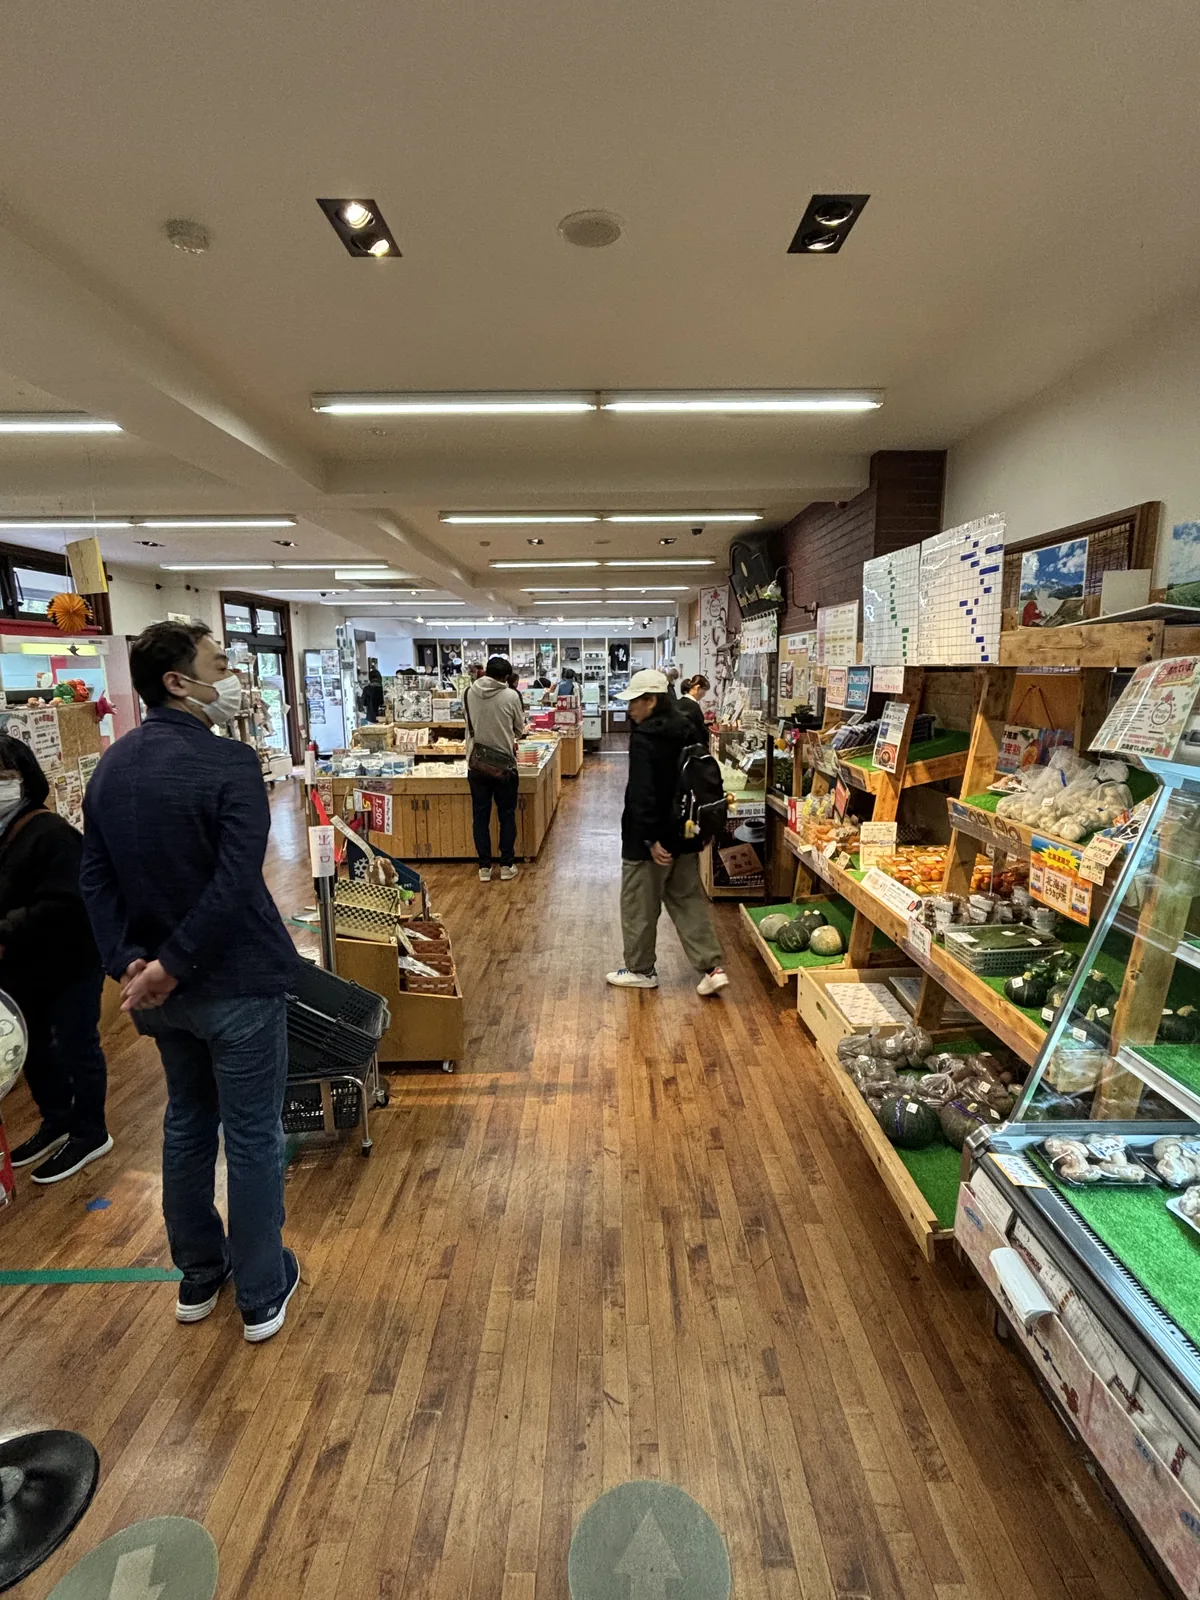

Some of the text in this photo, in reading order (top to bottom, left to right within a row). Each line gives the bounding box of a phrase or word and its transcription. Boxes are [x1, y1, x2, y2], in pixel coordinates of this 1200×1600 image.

[362, 798, 371, 808] 5
[375, 798, 383, 825] 1,500
[1045, 875, 1067, 894] 北海道
